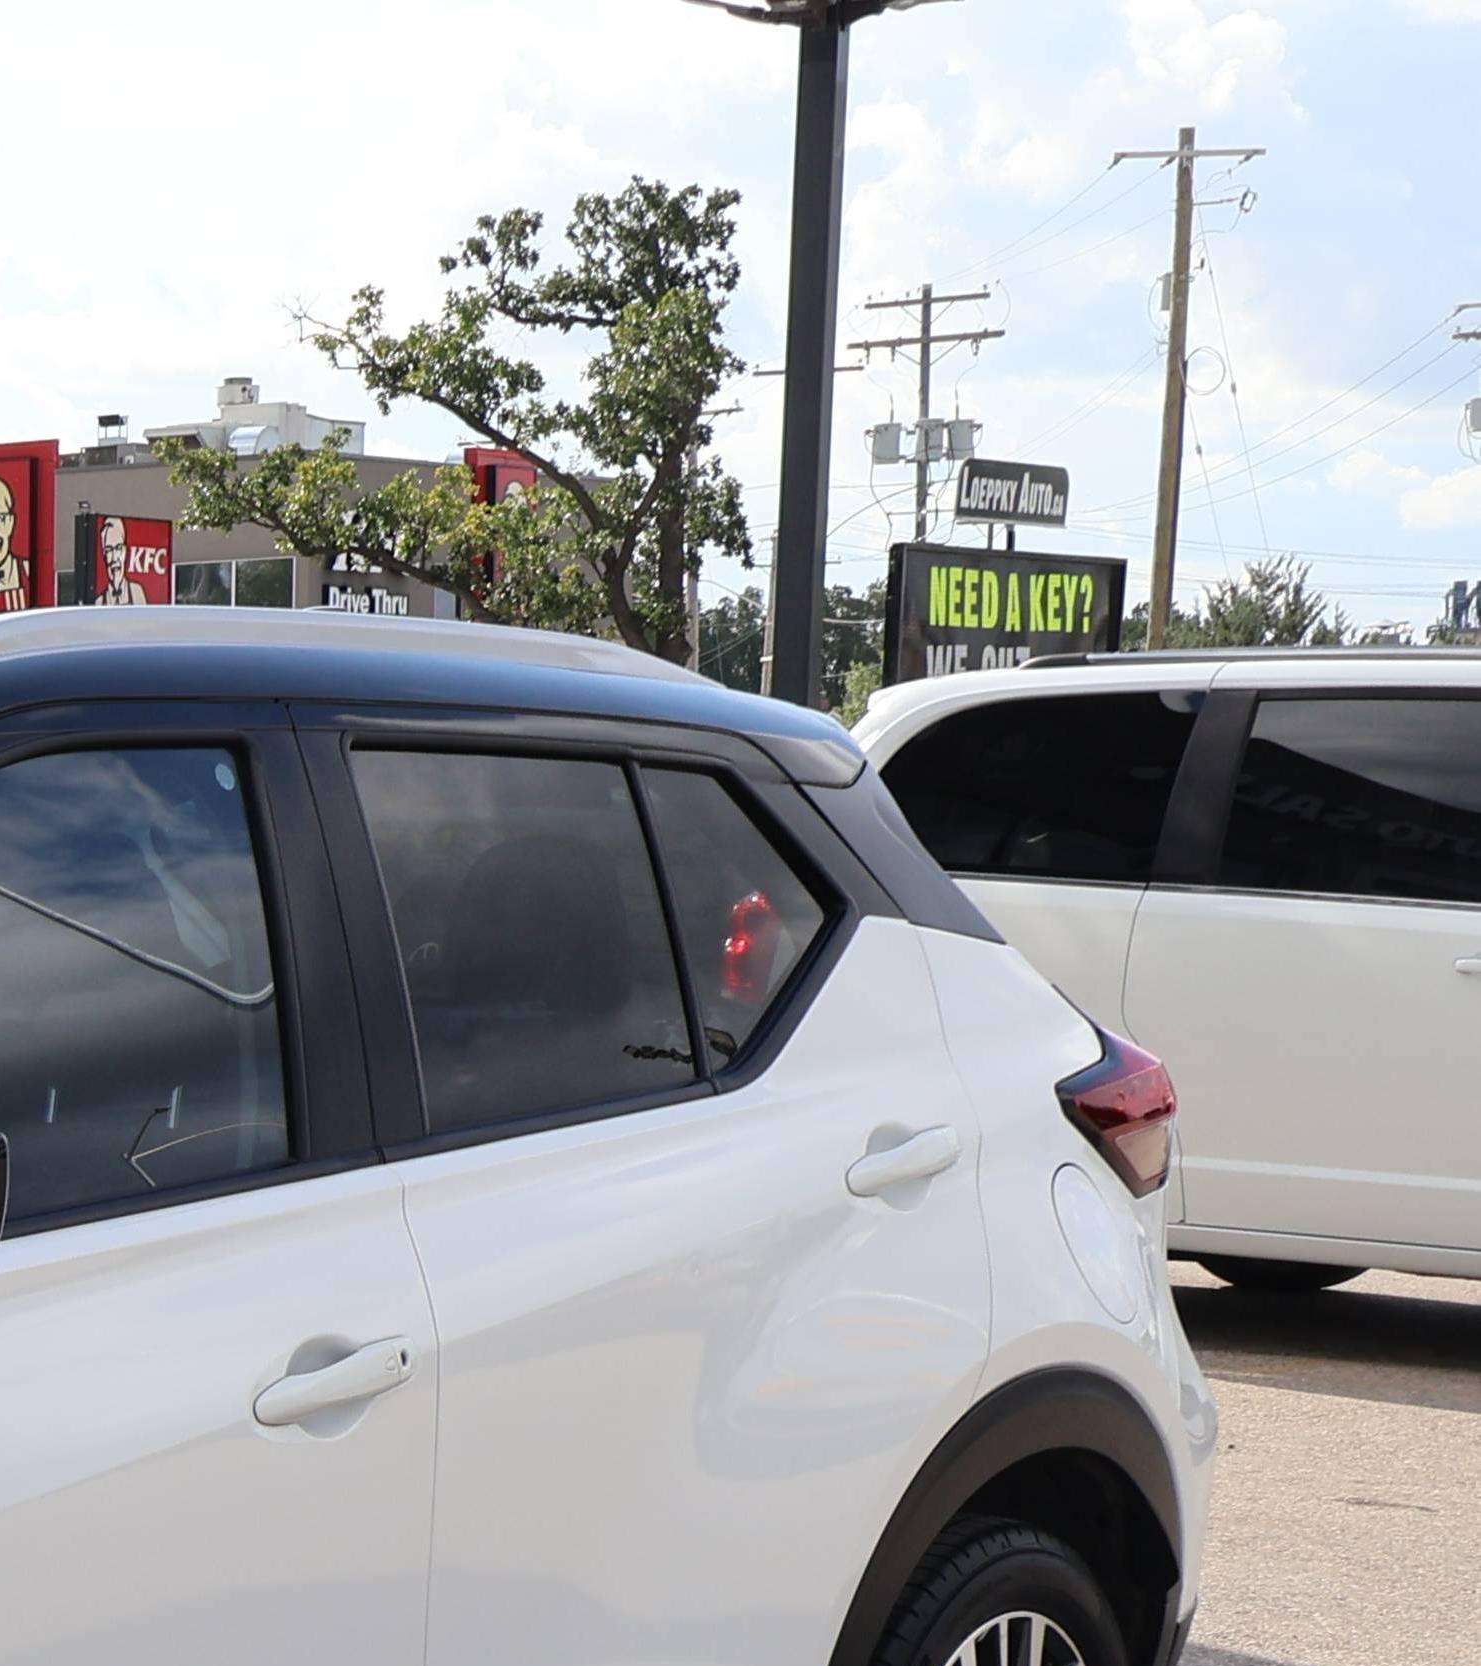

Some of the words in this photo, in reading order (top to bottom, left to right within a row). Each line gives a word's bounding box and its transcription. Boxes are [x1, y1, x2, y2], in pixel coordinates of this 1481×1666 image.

[128, 546, 167, 575] KFC
[328, 585, 369, 613] Drive
[371, 588, 407, 615] Thru
[929, 566, 999, 629] NEED
[1004, 572, 1021, 632] A
[1029, 574, 1094, 633] KEY?
